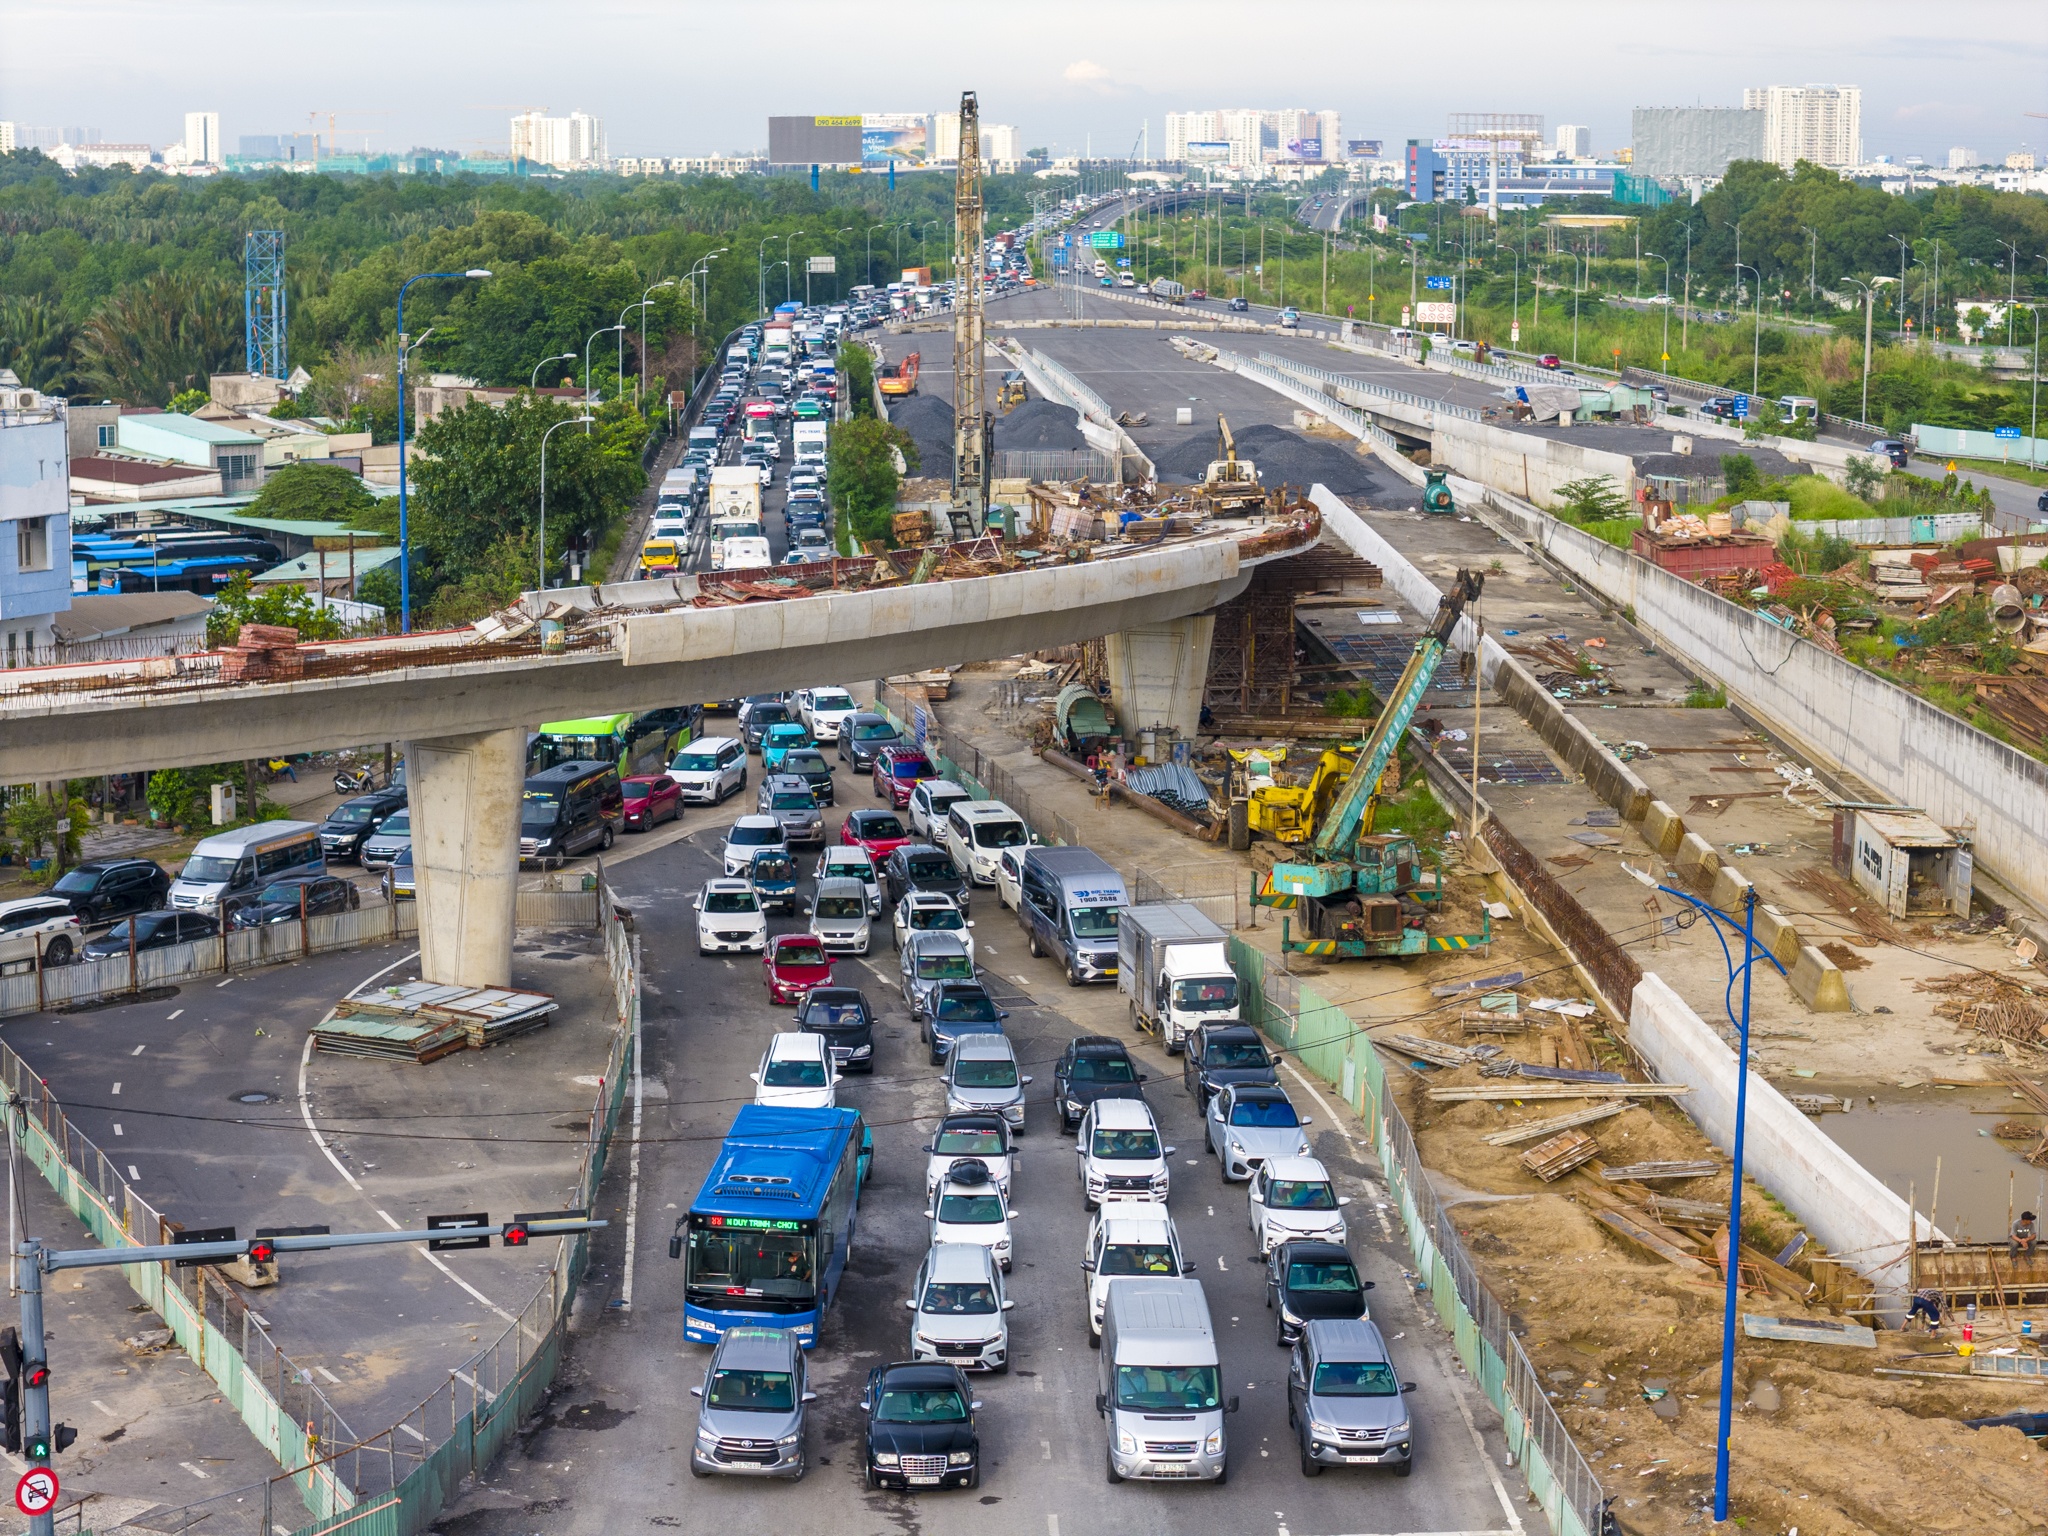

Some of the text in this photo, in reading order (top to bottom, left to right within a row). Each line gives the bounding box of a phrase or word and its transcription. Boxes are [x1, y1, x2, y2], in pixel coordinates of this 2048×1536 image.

[1452, 151, 1491, 159] AMERICAN
[1283, 874, 1313, 885] KATO
[733, 1218, 748, 1227] DUY
[749, 1219, 771, 1228] TRINH
